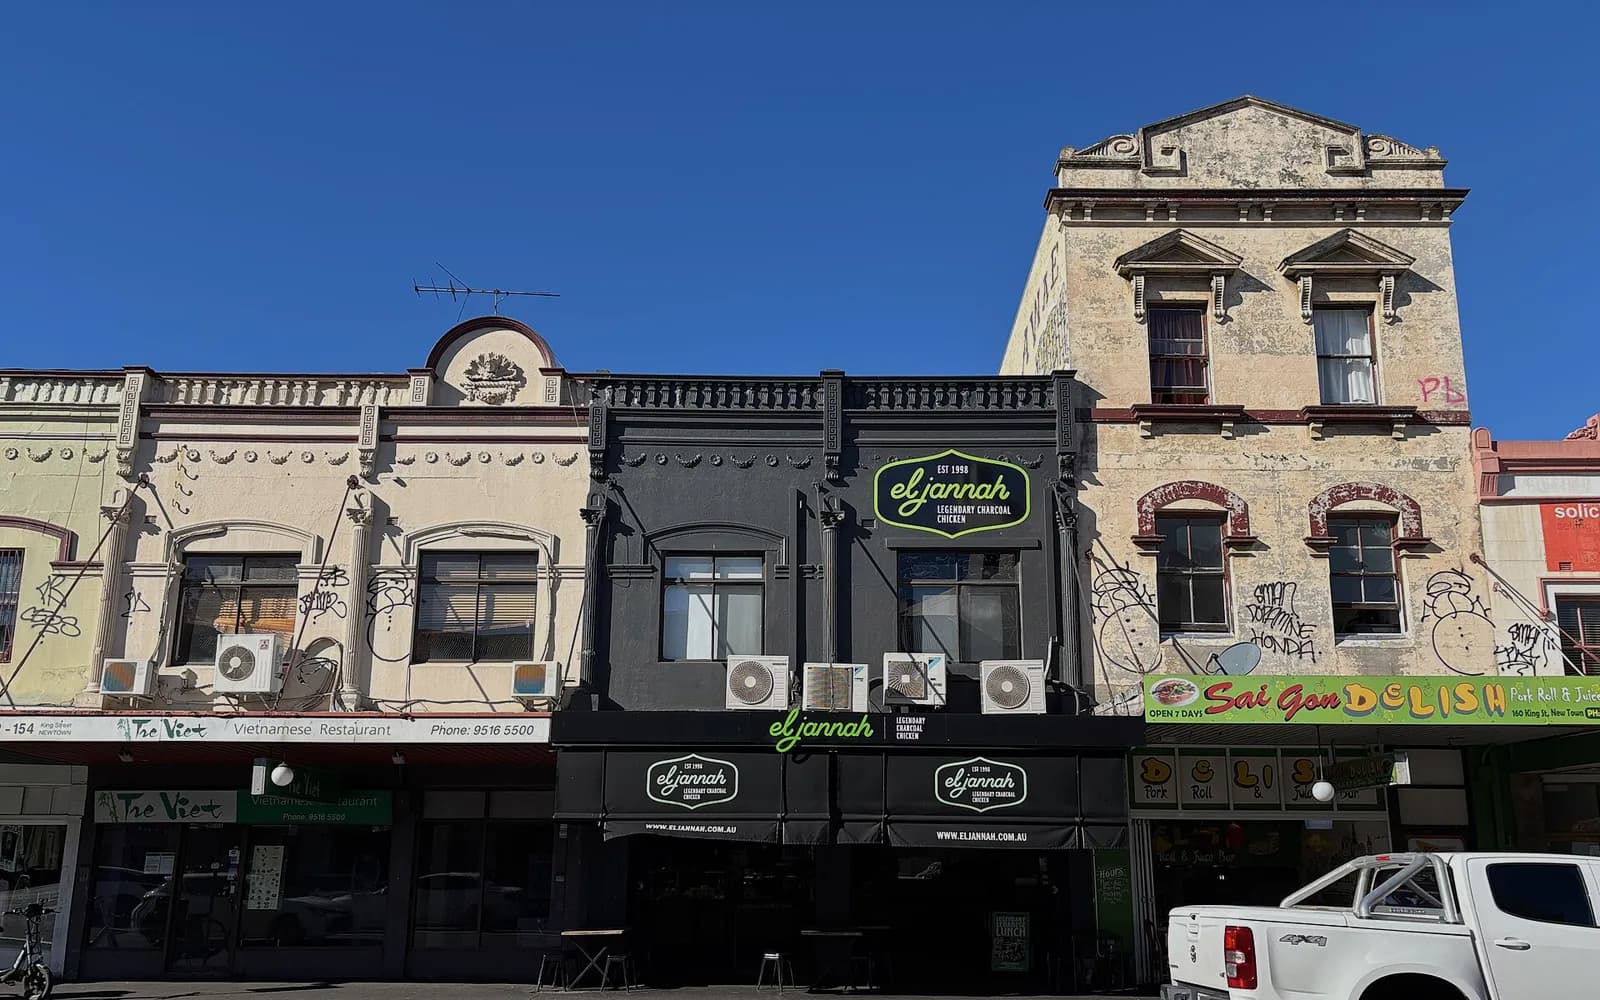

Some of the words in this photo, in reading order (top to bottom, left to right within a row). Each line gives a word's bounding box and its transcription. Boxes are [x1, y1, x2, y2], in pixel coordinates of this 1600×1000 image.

[937, 464, 949, 474] EST
[951, 464, 969, 474] 1998
[937, 505, 975, 514] LEGENDARY
[977, 505, 1011, 515] CHARCOAL
[937, 514, 966, 524] CHICKEN
[1510, 687, 1534, 703] Pork
[1537, 687, 1557, 701] Roll
[1561, 687, 1571, 702] &
[1204, 682, 1271, 715] Sai
[1277, 684, 1341, 721] Gon
[1343, 683, 1506, 719] DELISH
[1149, 710, 1174, 718] OPEN
[1175, 710, 1180, 718] 7
[1181, 710, 1203, 718] DAYS
[1512, 709, 1524, 717] 160
[1525, 709, 1540, 718] King
[1551, 708, 1565, 717] New
[1567, 708, 1584, 717] Town
[896, 716, 925, 724] LEGENDARY
[131, 718, 157, 738] Tre
[163, 718, 208, 739] Viet
[234, 723, 312, 736] Vietnamese
[320, 723, 391, 736] Restaurant
[431, 724, 471, 736] Phone:
[473, 724, 501, 736] 9516
[503, 724, 534, 736] 5500
[896, 724, 923, 732] CHARCOAL
[896, 732, 919, 740] CHICKEN
[1145, 785, 1168, 799] Pork
[1192, 785, 1212, 799] Roll
[117, 792, 156, 819] Tre
[160, 791, 223, 820] Viet
[645, 823, 737, 834] WWW.ELJANNAH.COM.AU
[936, 831, 1027, 842] WWW.ELJANNAH.COM.AU
